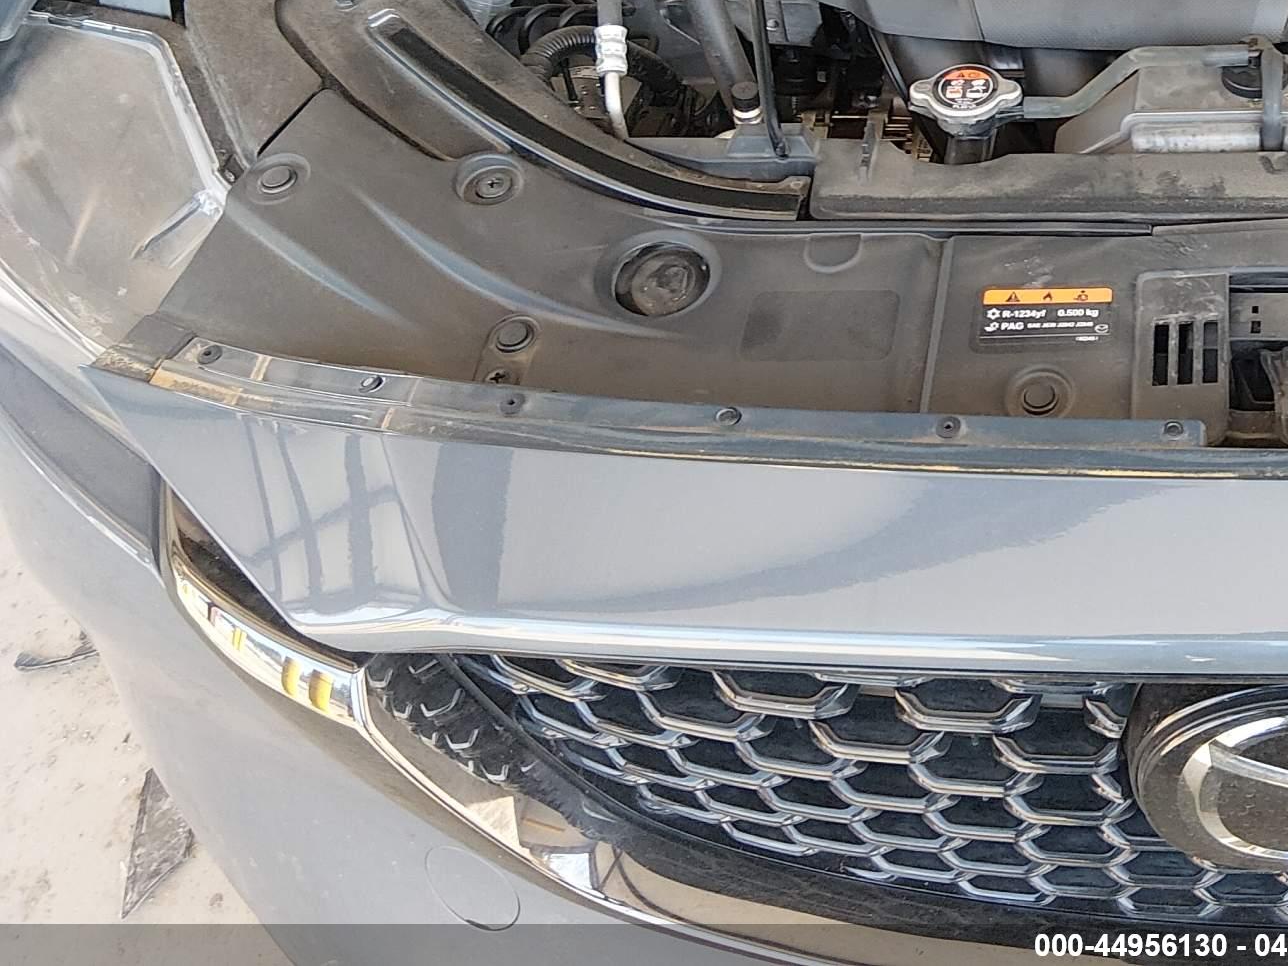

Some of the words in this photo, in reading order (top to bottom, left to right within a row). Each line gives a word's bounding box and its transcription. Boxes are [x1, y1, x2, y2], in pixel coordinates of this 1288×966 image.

[1001, 309, 1047, 319] R-1234yf
[1057, 308, 1085, 317] 0.500
[1085, 307, 1100, 318] kg
[1000, 321, 1025, 331] PAG
